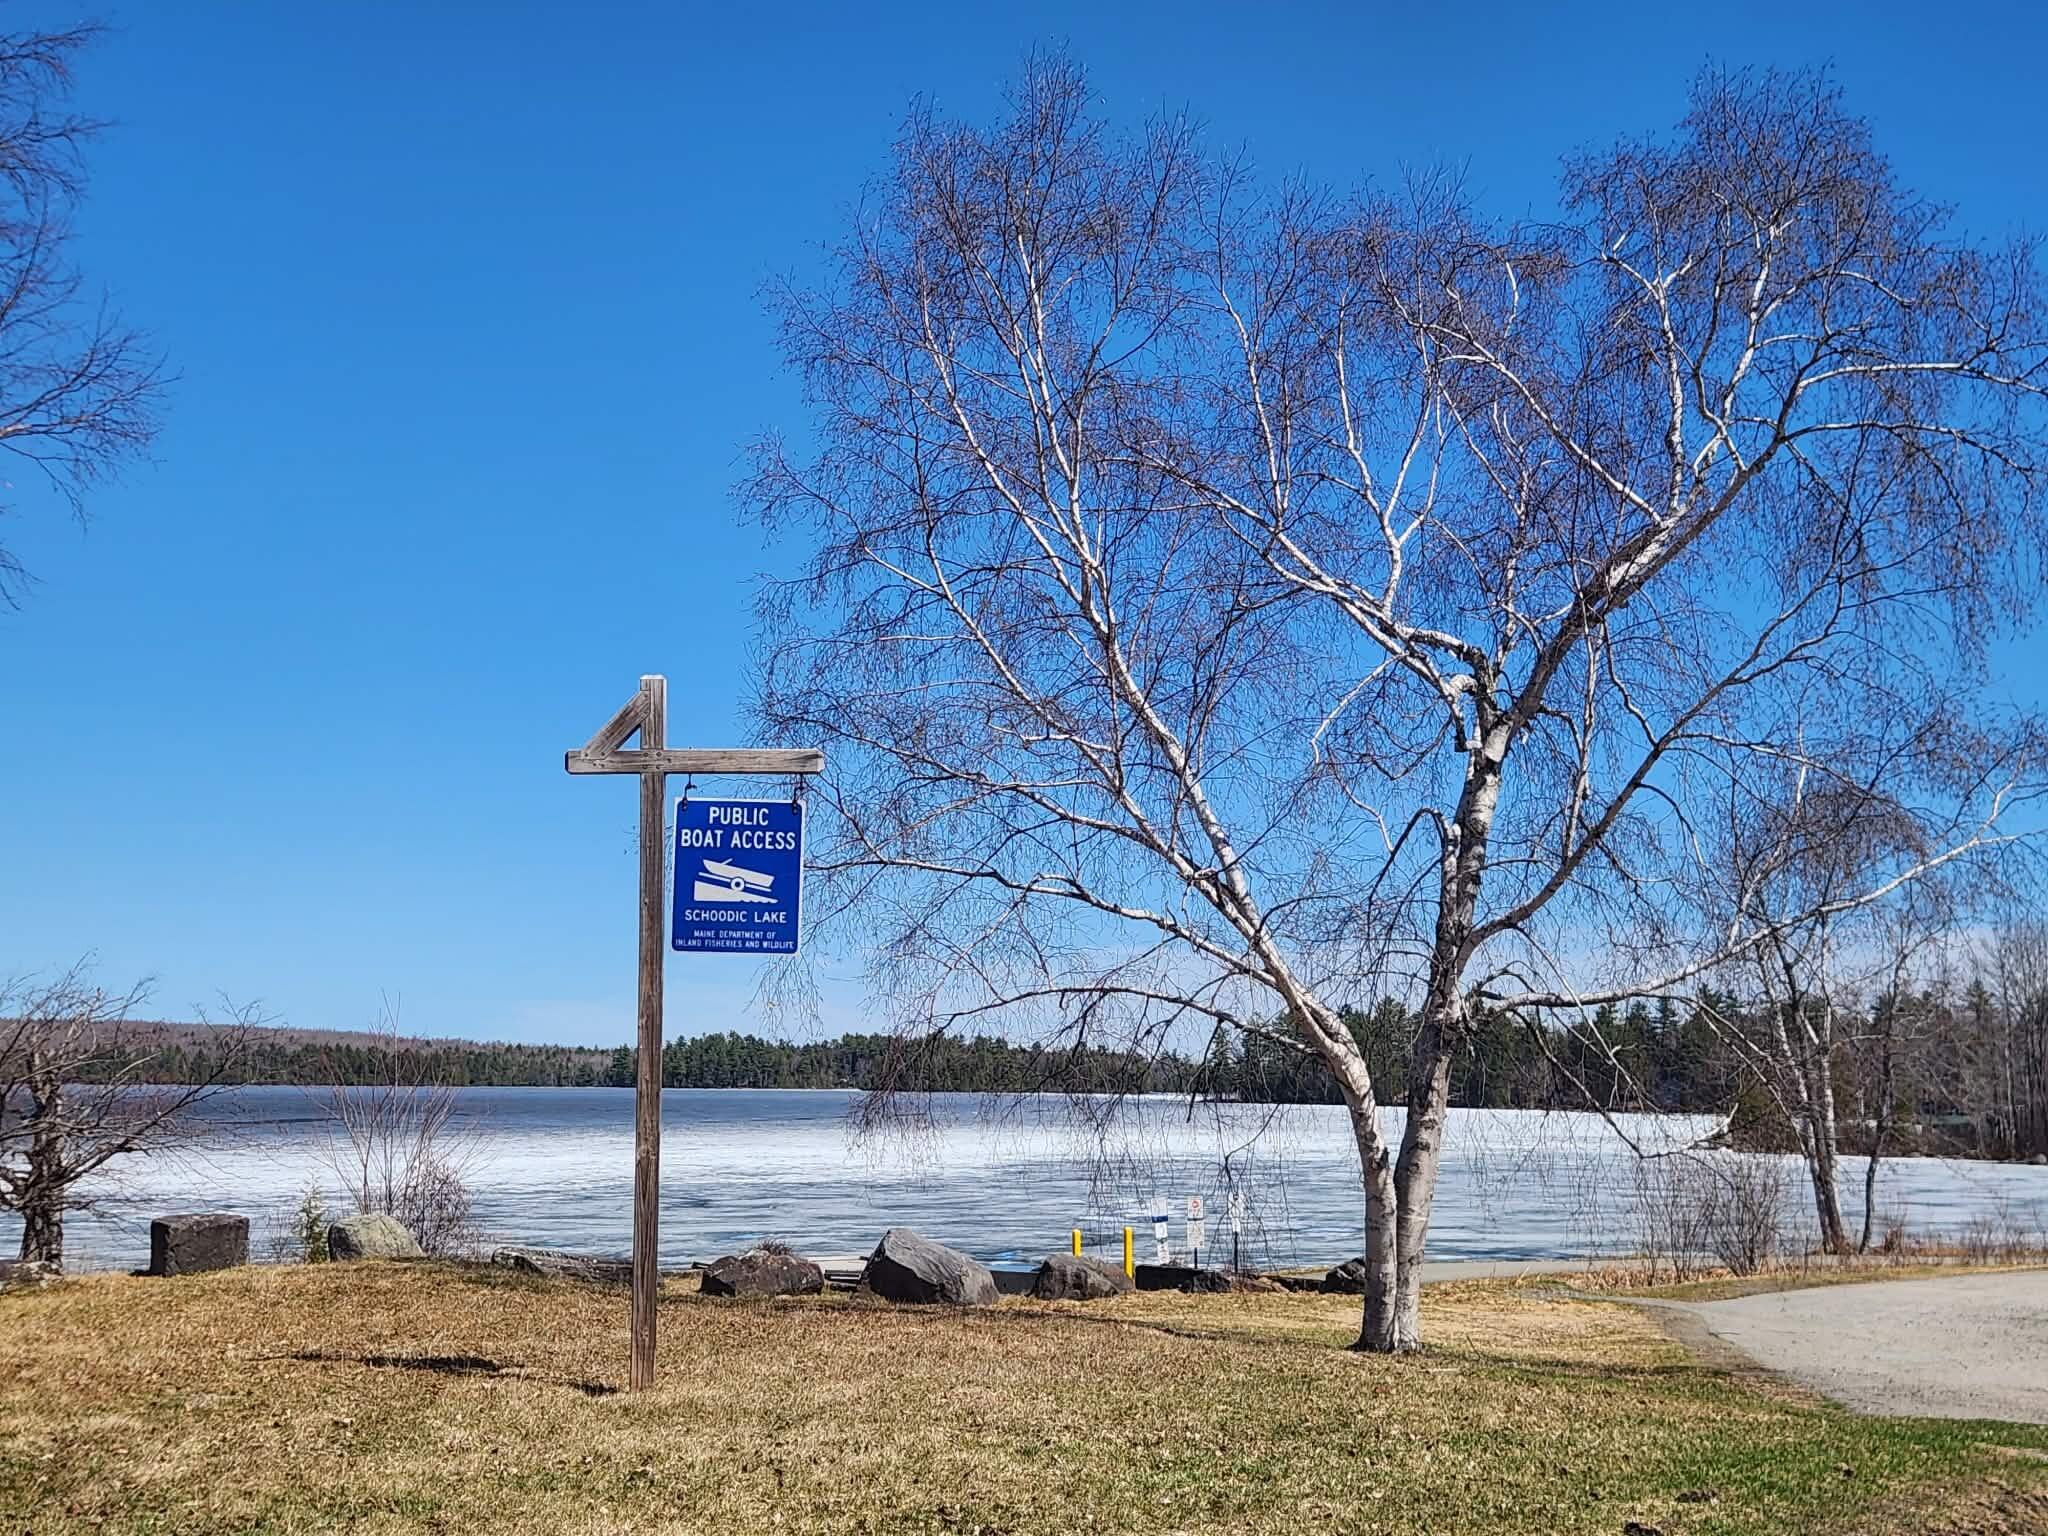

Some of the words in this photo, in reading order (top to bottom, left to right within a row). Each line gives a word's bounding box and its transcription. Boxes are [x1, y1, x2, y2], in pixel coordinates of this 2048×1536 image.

[709, 806, 769, 826] PUBLIC
[681, 829, 724, 848] BOAT
[731, 830, 796, 850] ACCESS
[684, 909, 748, 922] SCHOODIC
[754, 911, 787, 924] LAKE
[694, 930, 716, 938] MAINE
[719, 930, 763, 939] DEPARTMENT
[766, 931, 776, 939] OF
[675, 938, 702, 947] INLAND
[705, 939, 742, 948] FISHERIES
[745, 940, 760, 948] AND
[762, 940, 795, 949] WILDLIFE
